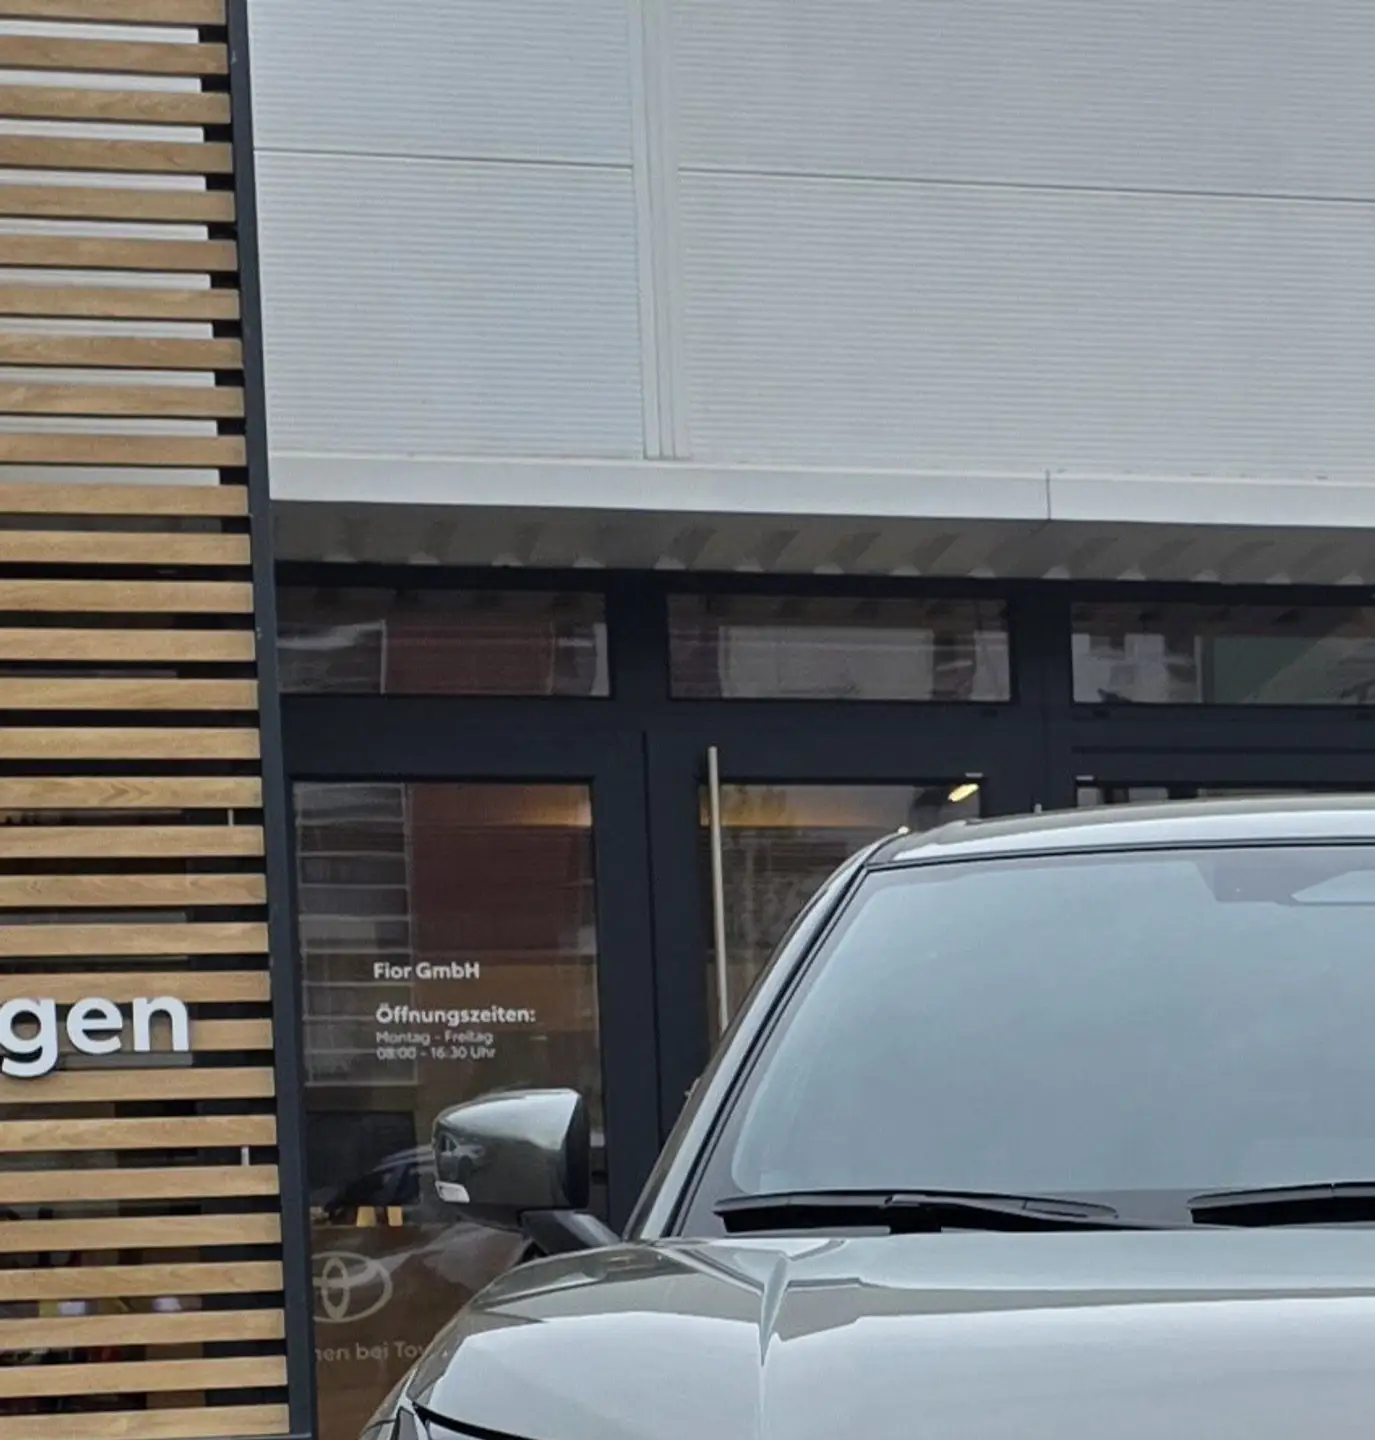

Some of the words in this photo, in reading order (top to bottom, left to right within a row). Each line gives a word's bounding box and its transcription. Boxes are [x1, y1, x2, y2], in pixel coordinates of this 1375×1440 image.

[373, 962, 412, 979] Fior
[416, 962, 480, 979] GmbH
[376, 1003, 536, 1026] Öffnungszeiten:
[376, 1031, 430, 1046] Montag
[444, 1030, 494, 1045] Freitag
[470, 1046, 496, 1059] Uhr
[356, 1342, 389, 1360] bei
